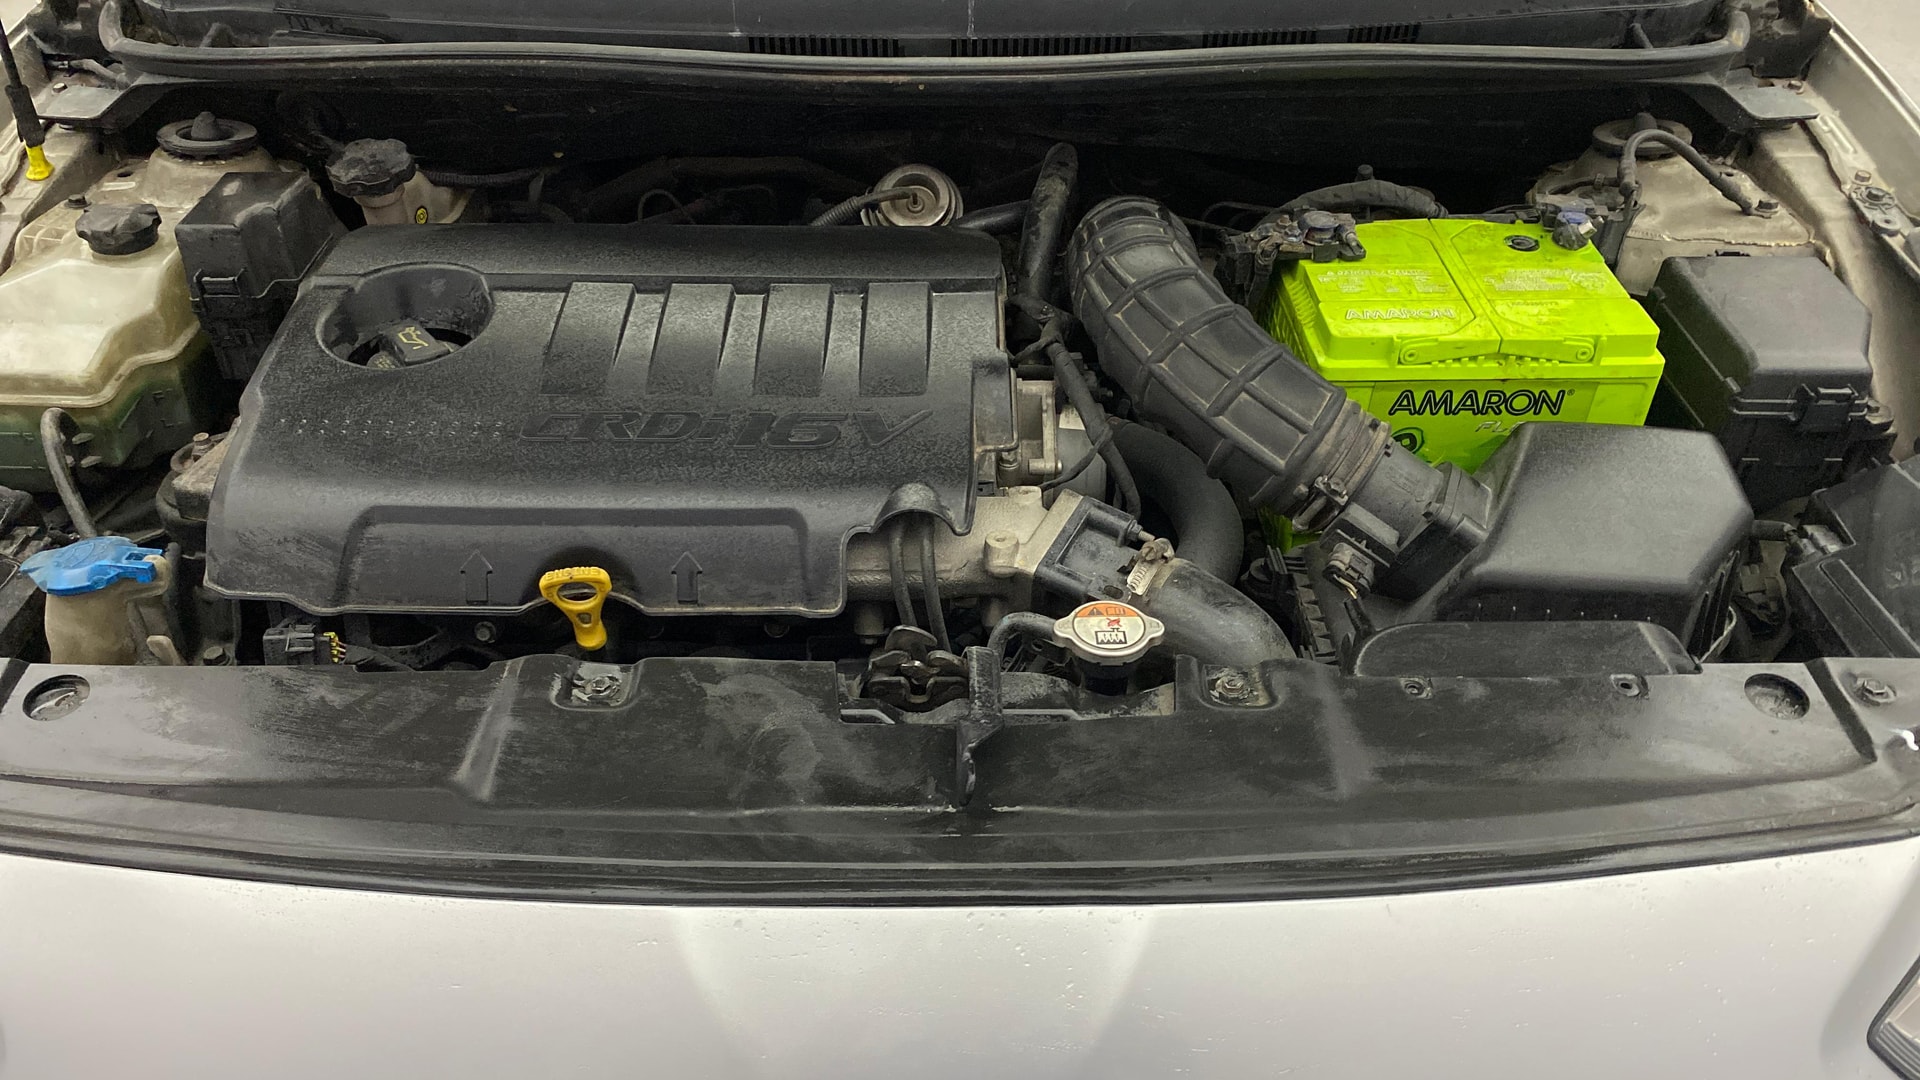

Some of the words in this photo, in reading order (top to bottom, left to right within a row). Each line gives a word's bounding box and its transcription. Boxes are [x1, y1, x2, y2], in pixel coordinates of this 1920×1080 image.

[1346, 308, 1456, 320] AMARON
[1388, 389, 1566, 416] AMARON
[545, 567, 600, 581] ENGINE
